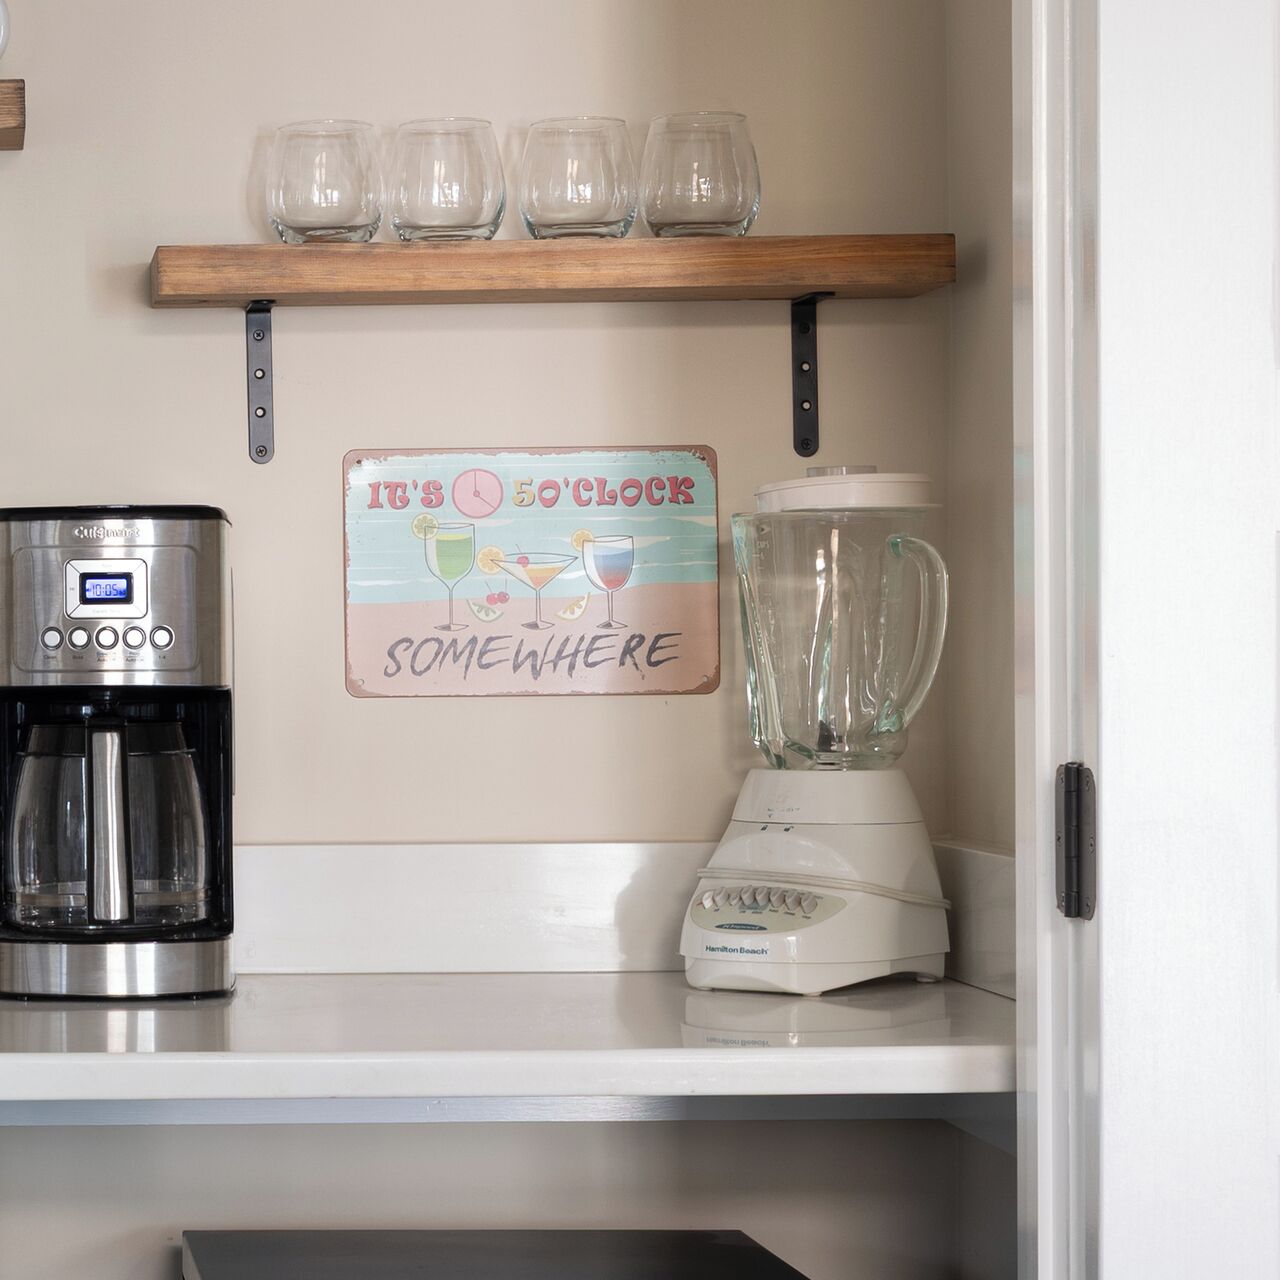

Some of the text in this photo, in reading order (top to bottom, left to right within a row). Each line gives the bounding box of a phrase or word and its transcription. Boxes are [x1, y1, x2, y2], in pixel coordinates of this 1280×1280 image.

[367, 479, 444, 510] IT'S
[92, 583, 118, 597] 10:05
[383, 632, 683, 680] SOMEWHERE
[705, 945, 768, 955] Hamilton Beach
